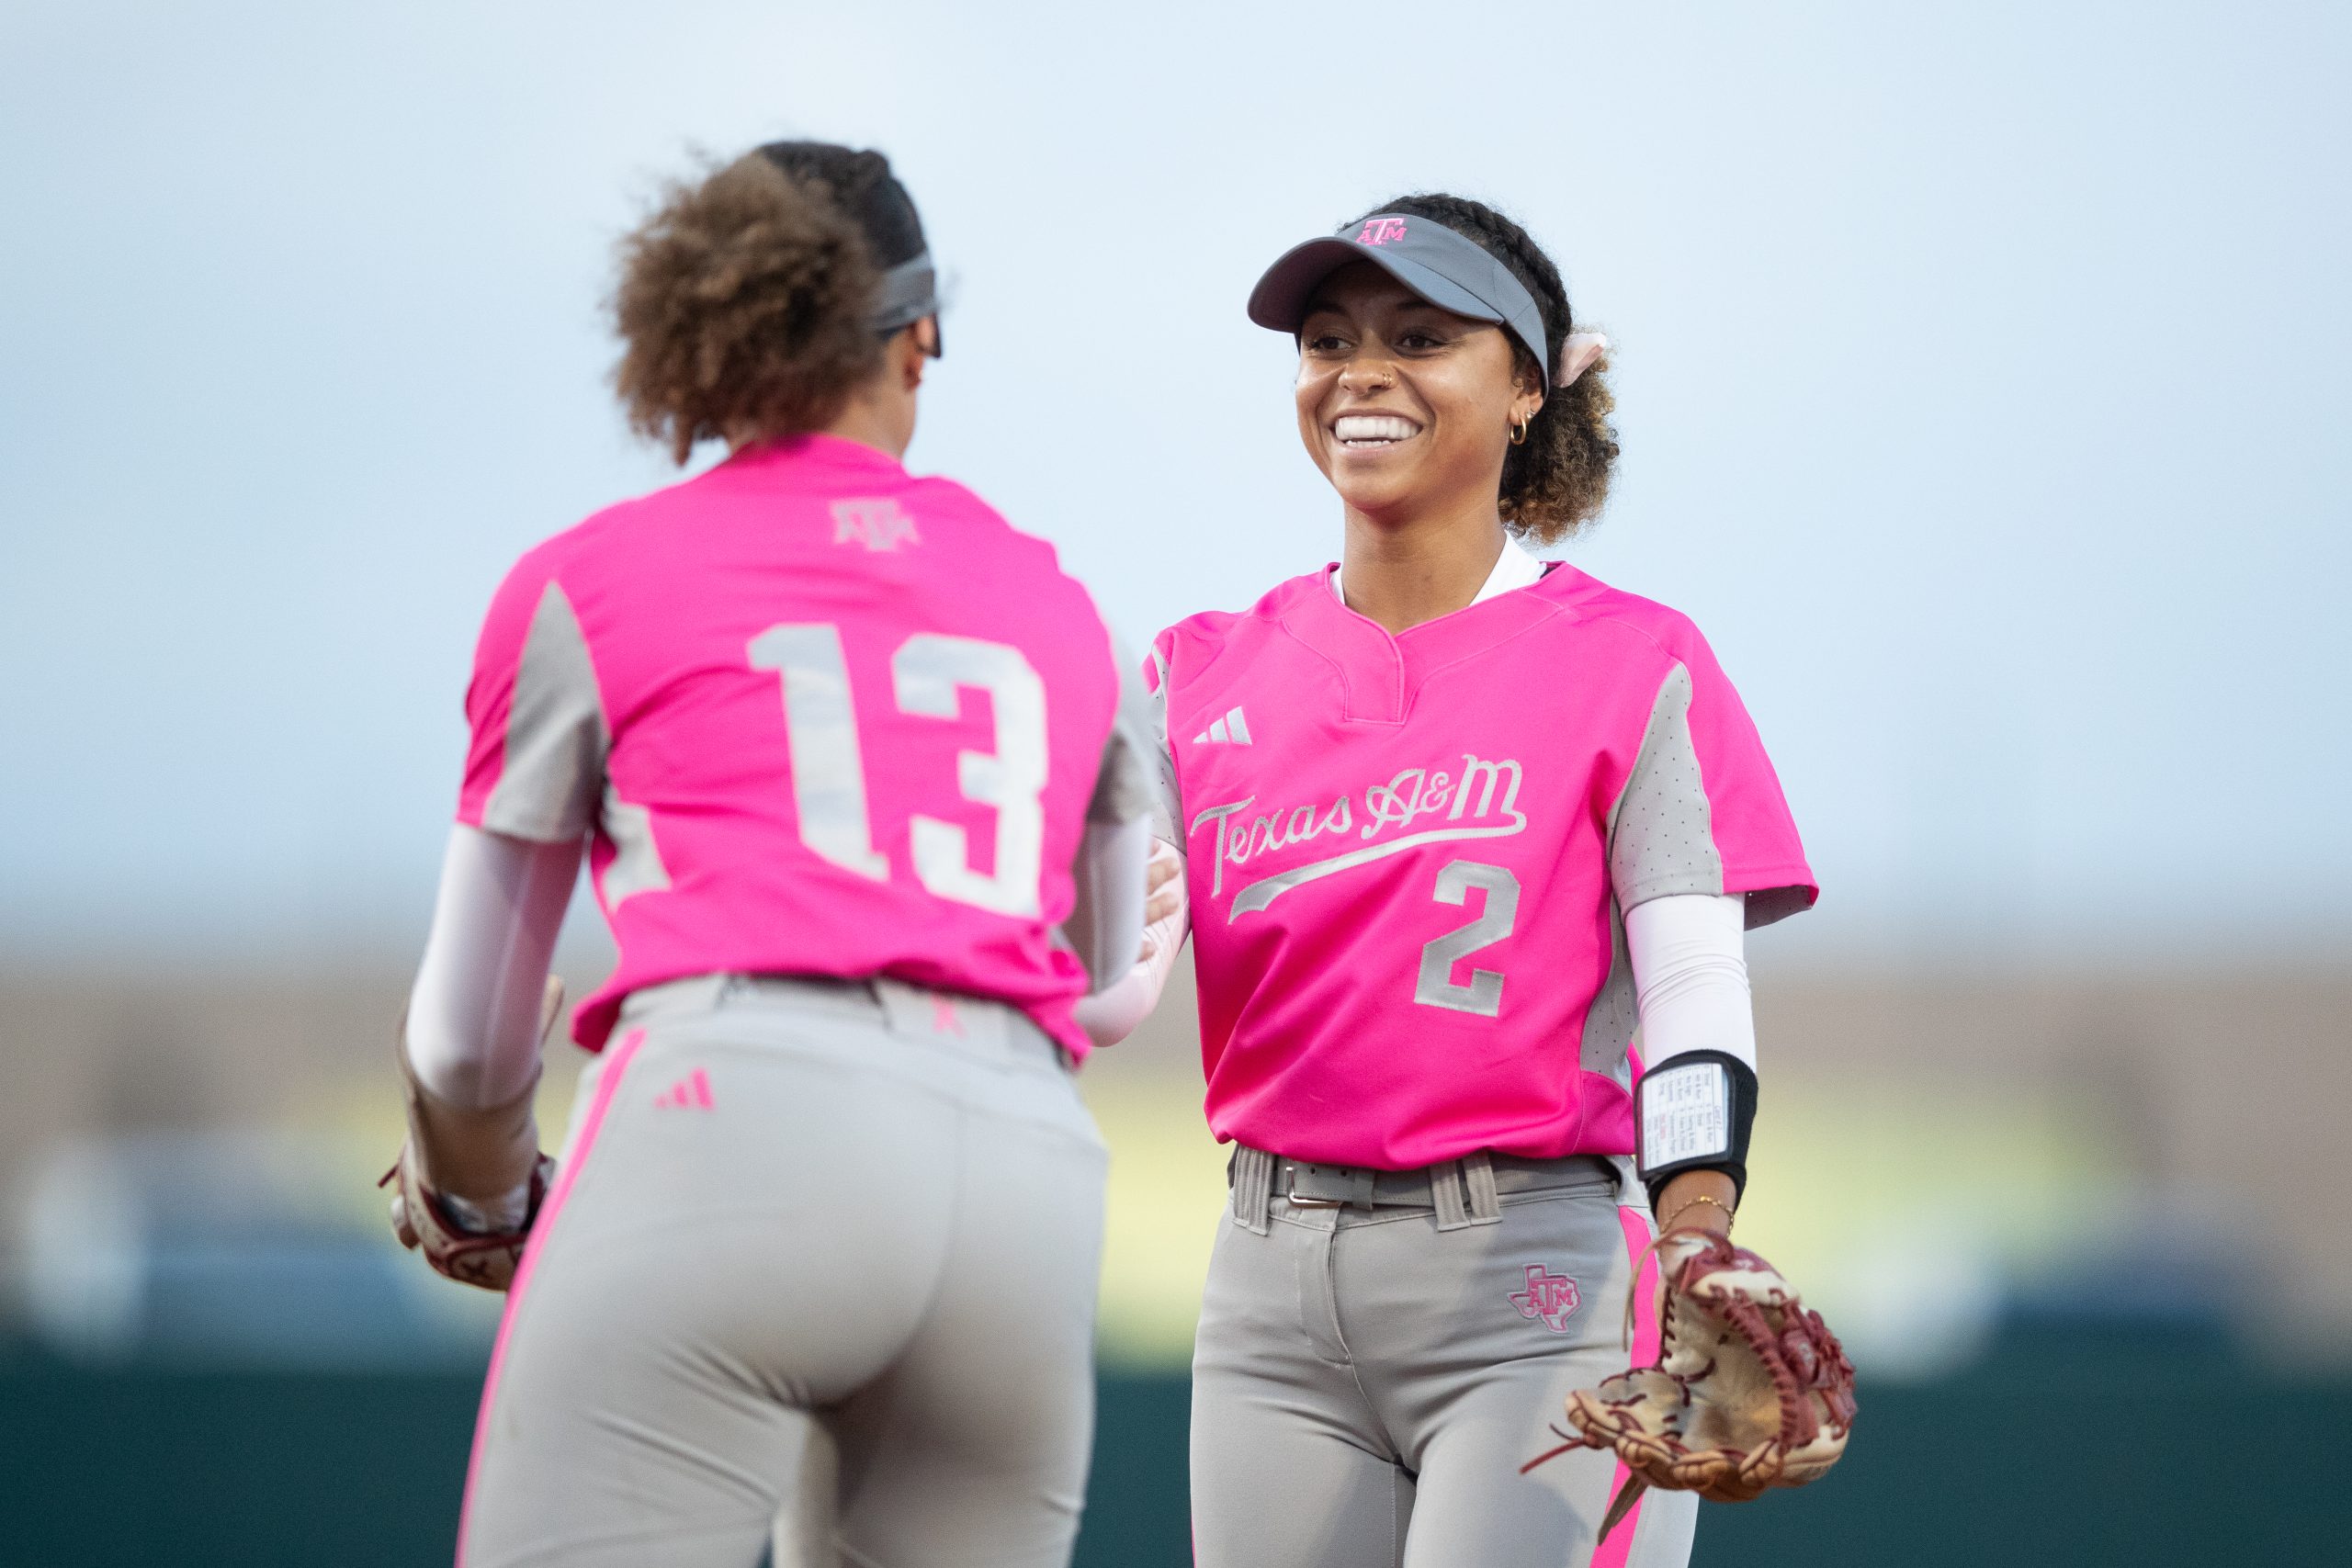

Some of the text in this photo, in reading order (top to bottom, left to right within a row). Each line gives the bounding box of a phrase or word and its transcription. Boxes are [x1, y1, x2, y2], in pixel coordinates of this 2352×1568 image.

[746, 622, 1048, 919] 13
[1190, 753, 1528, 898] Texas A&M
[1414, 860, 1521, 1017] 2
